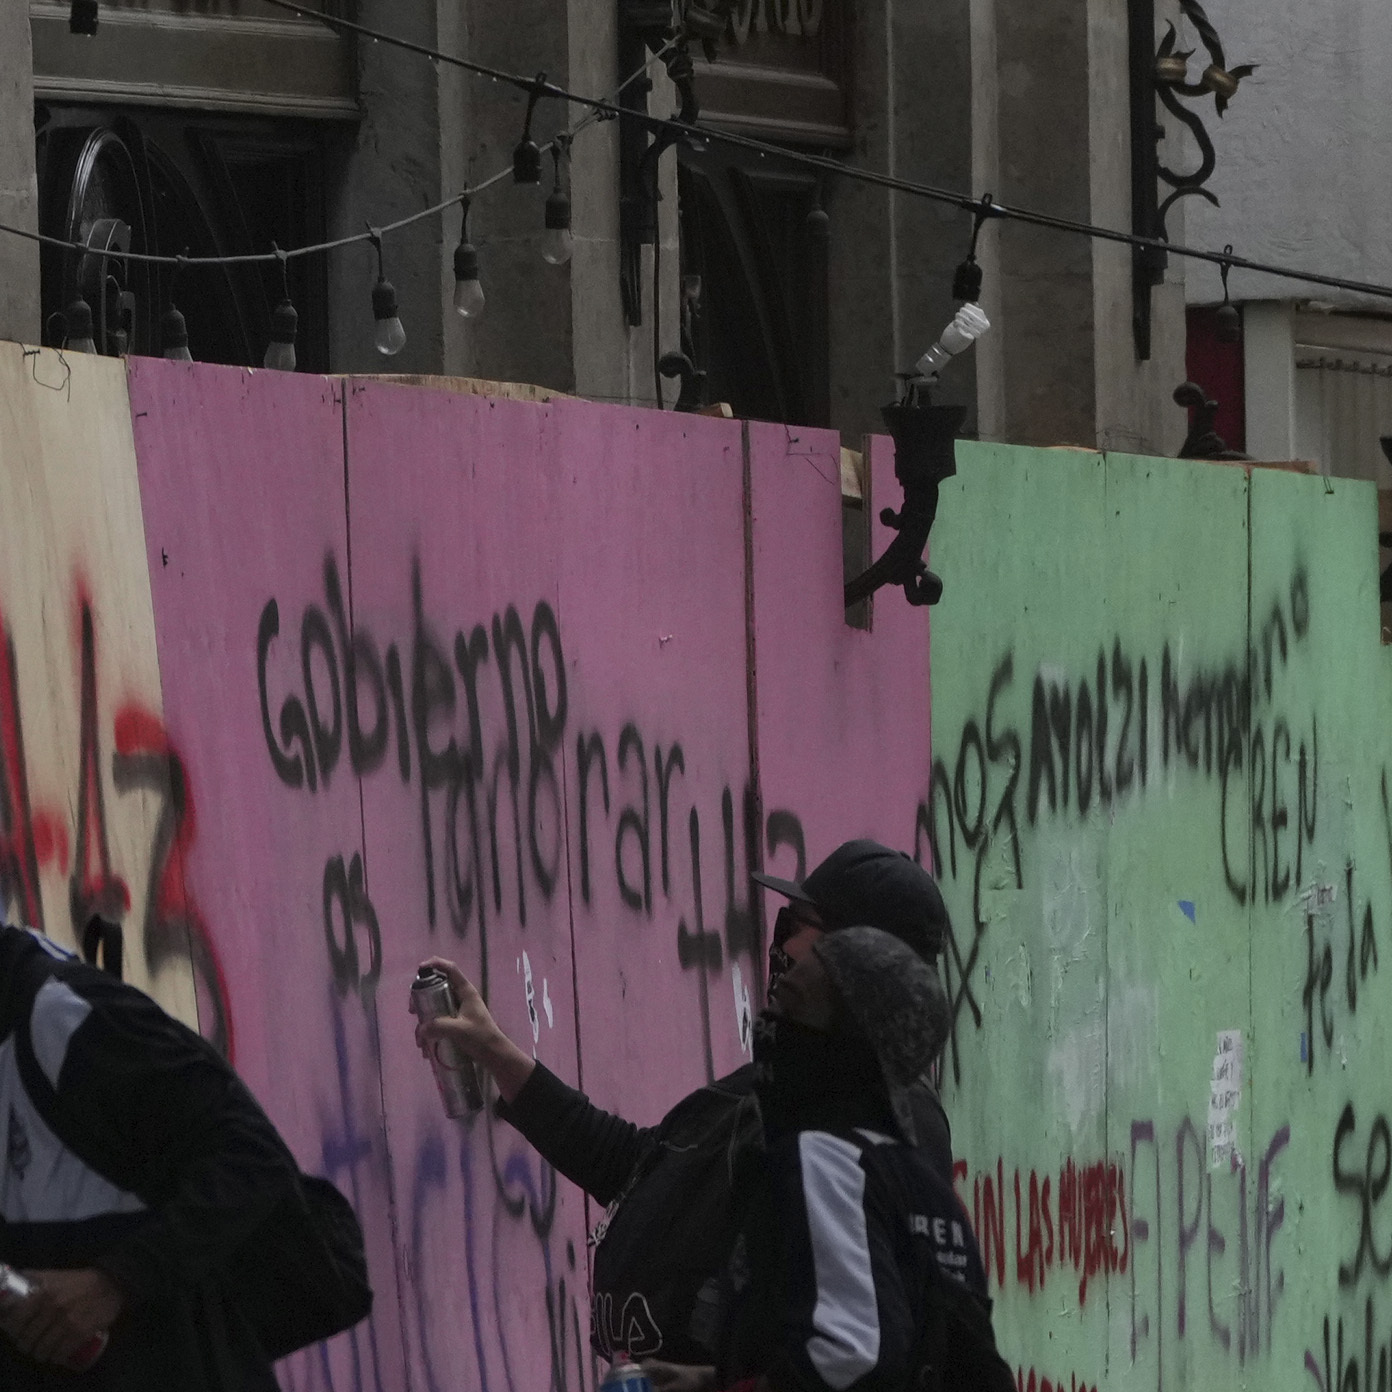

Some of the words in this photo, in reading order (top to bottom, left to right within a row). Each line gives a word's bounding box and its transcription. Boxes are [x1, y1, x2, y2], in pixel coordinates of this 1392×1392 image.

[256, 545, 570, 795] Gobierno
[1015, 1168, 1055, 1296] LAS
[591, 1291, 663, 1357] ILA
